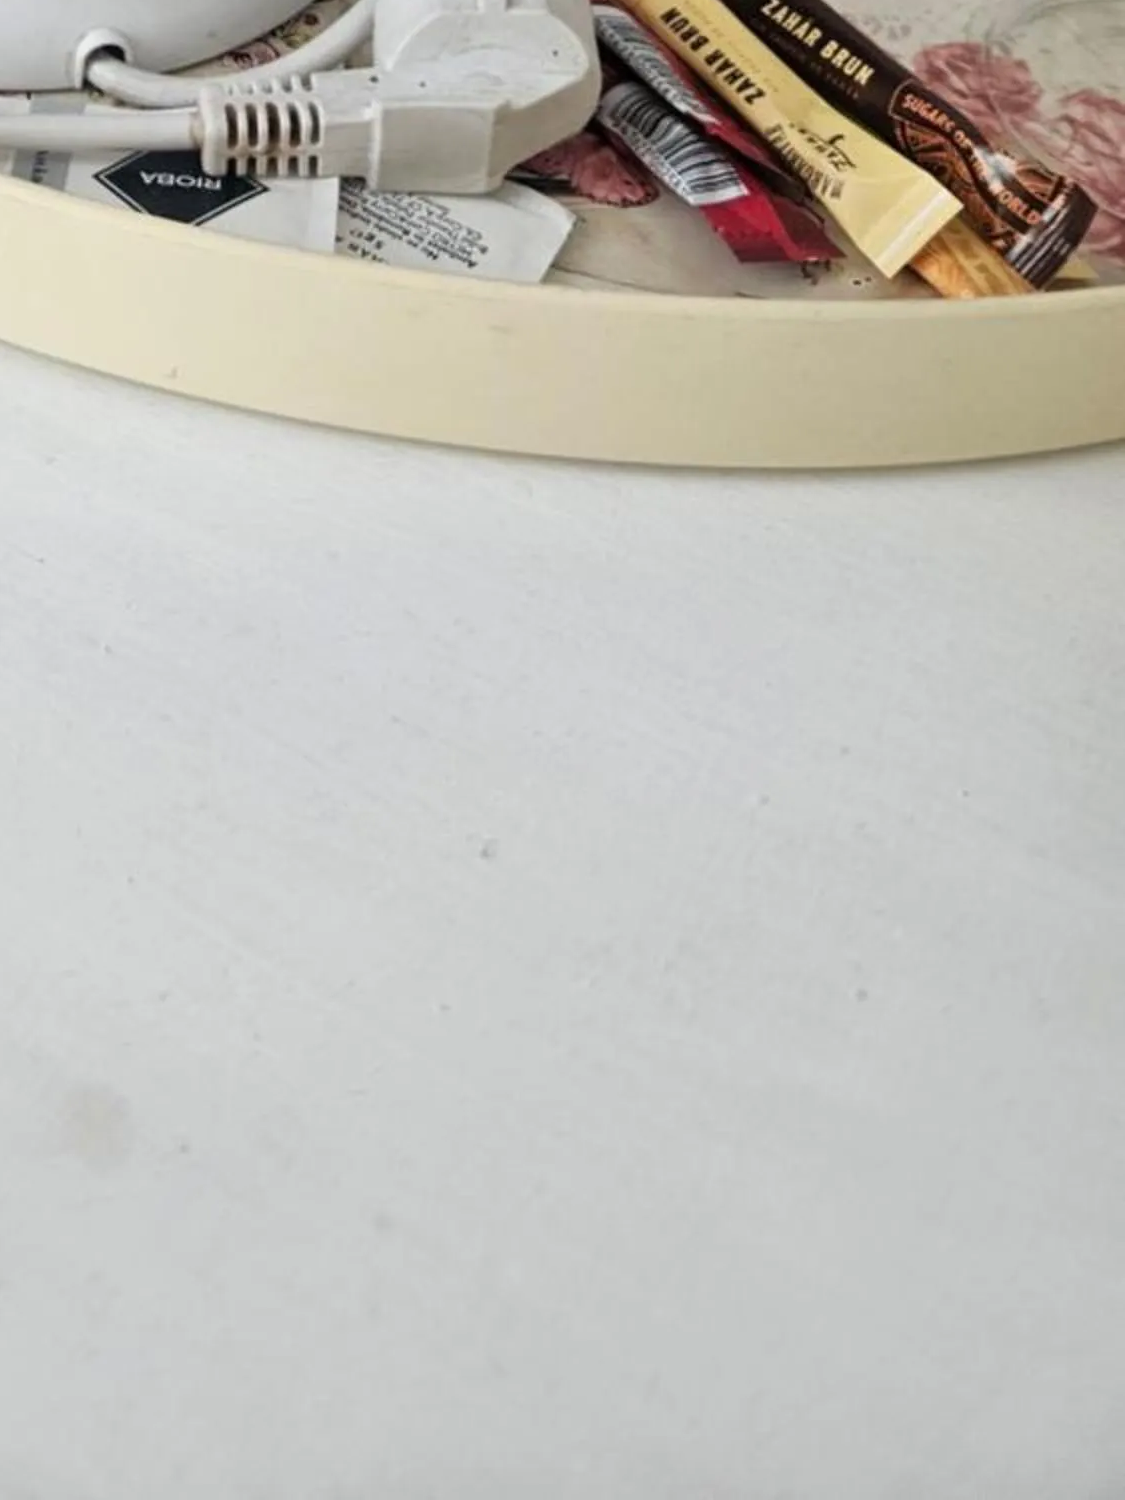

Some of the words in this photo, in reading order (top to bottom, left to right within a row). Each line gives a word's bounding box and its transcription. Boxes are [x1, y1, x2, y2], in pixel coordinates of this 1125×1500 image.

[660, 7, 711, 52] BRUN
[819, 40, 875, 88] BRUN
[139, 170, 223, 191] RIOBA
[901, 93, 956, 133] SUGARS
[953, 129, 973, 150] OF
[989, 179, 1043, 225] WORLD
